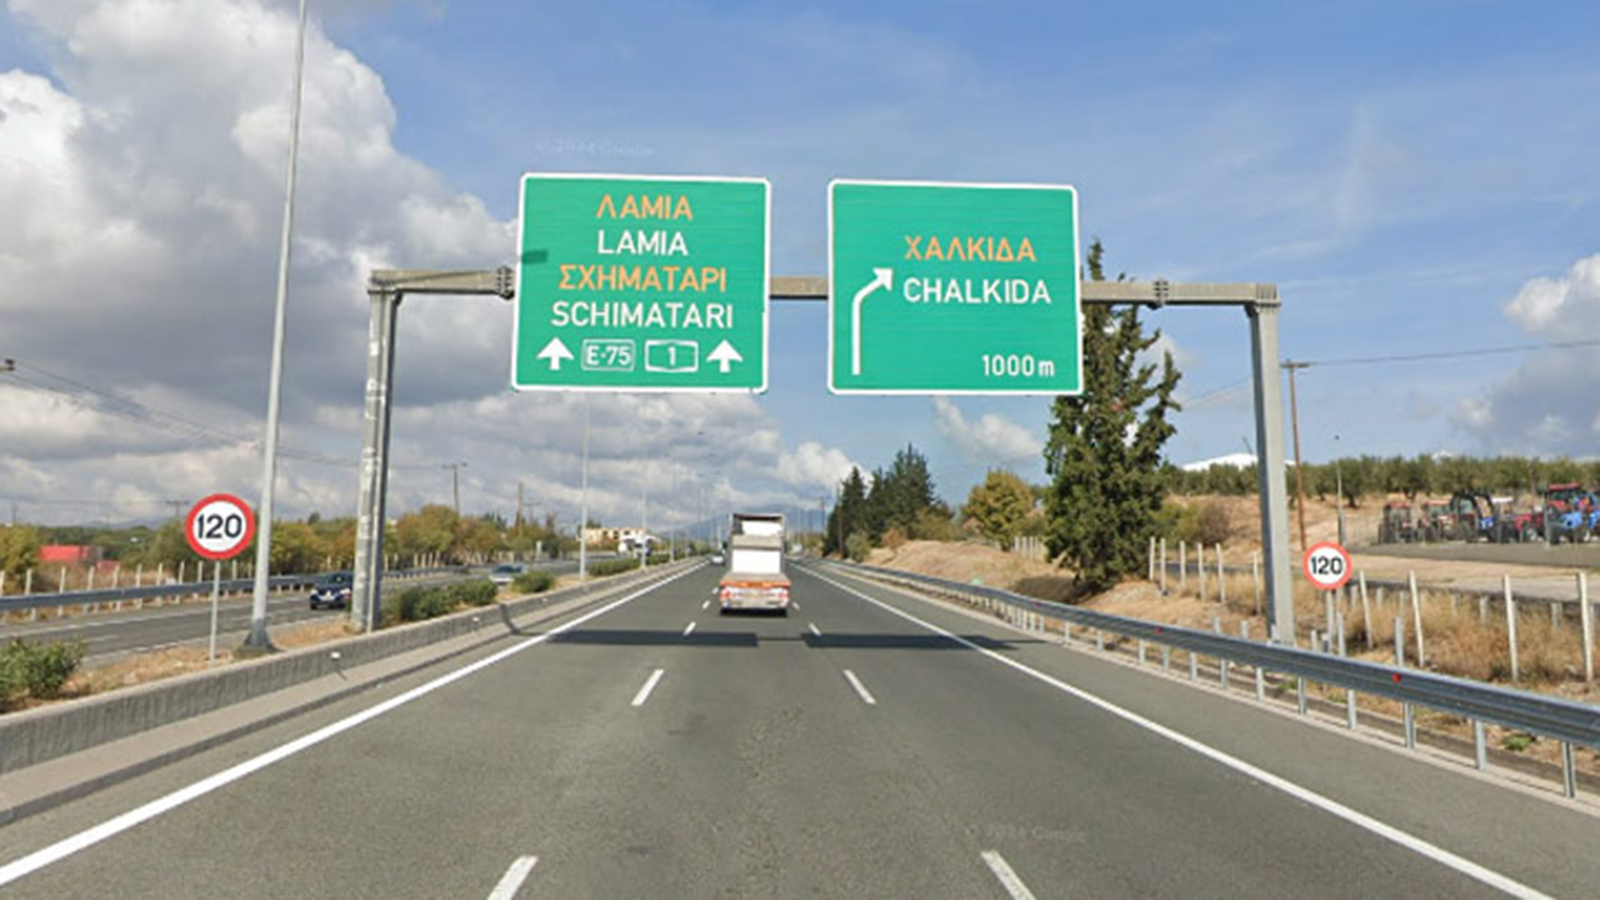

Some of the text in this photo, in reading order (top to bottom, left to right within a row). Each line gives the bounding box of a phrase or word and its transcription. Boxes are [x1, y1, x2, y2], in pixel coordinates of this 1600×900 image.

[596, 194, 693, 220] ΛΑΜΙΑ
[597, 229, 688, 256] LAMIA
[904, 235, 1036, 262] ΧΑΛΚΙΔΑ
[558, 264, 727, 292] ΣΧΗΜΑΤΑΡΙ
[903, 278, 1051, 304] CHALKIDA
[551, 300, 733, 329] SCHIMATARI
[667, 346, 676, 366] 1
[198, 513, 242, 539] 120
[1310, 555, 1342, 575] 120
